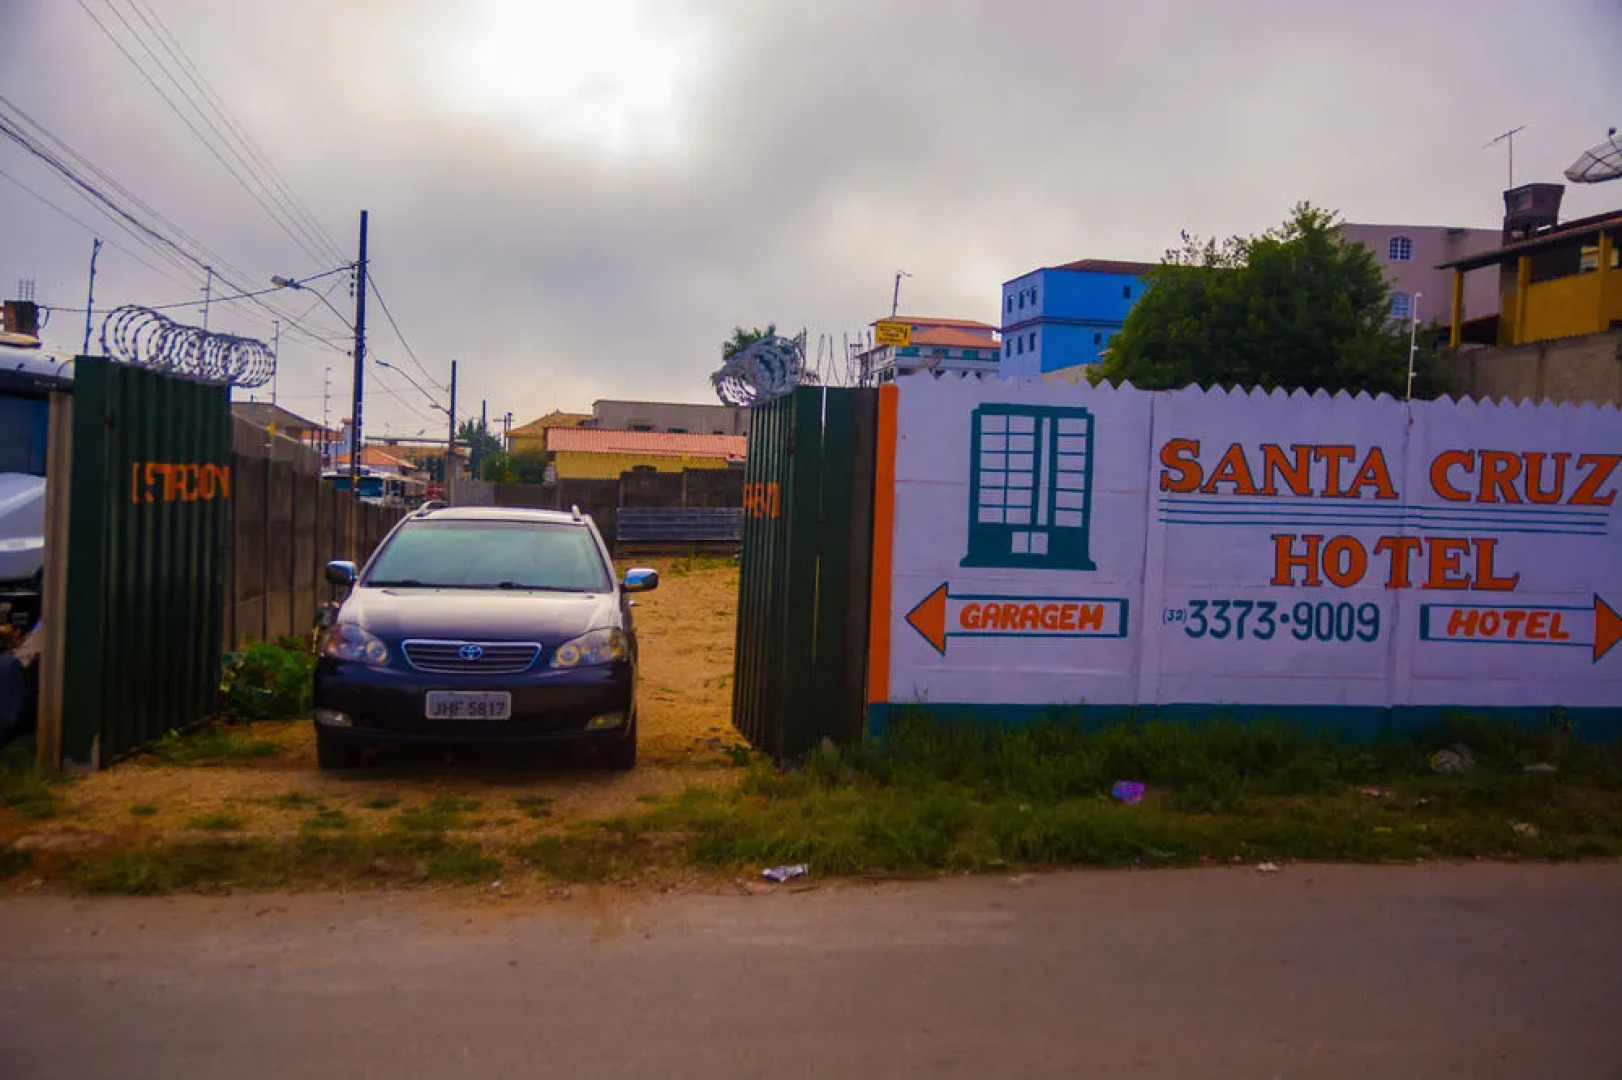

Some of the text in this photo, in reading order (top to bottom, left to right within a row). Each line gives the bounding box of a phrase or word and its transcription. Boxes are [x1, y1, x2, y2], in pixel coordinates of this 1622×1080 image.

[1159, 437, 1621, 507] SANTA CRUZ
[1269, 533, 1520, 592] HOTEL
[959, 602, 1106, 631] GARAGEM
[1162, 608, 1188, 625] (32)
[1446, 609, 1570, 640] HOTEL
